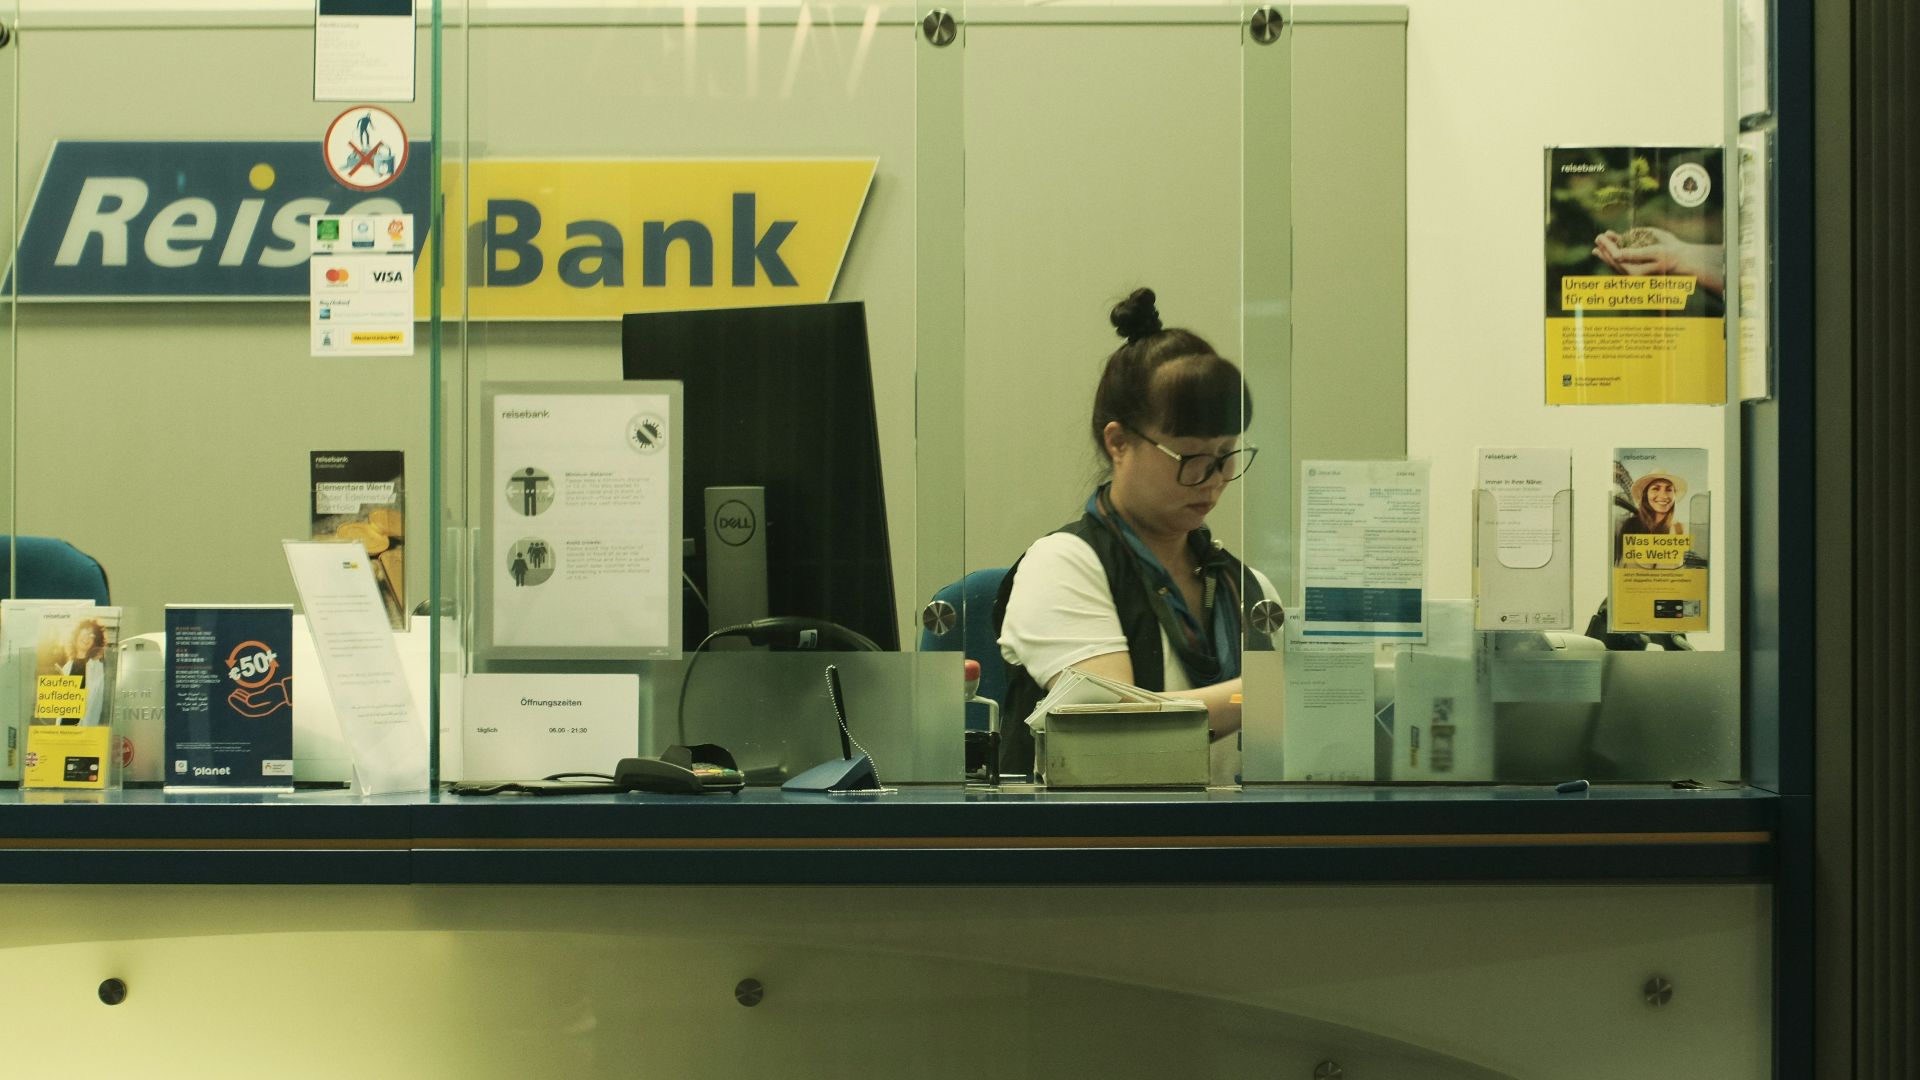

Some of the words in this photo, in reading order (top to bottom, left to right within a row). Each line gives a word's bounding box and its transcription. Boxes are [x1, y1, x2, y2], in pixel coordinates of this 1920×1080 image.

[1560, 162, 1606, 173] reisebank
[54, 163, 403, 268] Reis
[486, 192, 800, 289] Bank
[373, 271, 403, 283] VISA
[1565, 279, 1600, 290] Unser
[1603, 279, 1646, 290] aktiver
[1649, 279, 1693, 293] Beitrag
[1565, 294, 1583, 305] für
[1586, 295, 1605, 305] ein
[1608, 295, 1644, 307] gutes
[1647, 294, 1683, 305] Klima.
[502, 409, 550, 419] reisebank
[720, 517, 752, 529] DELL
[1625, 535, 1650, 546] Was
[1653, 535, 1690, 546] kostet
[1625, 549, 1642, 560] die
[1646, 549, 1679, 560] Welt?
[39, 677, 78, 689] Kaufen,
[38, 690, 84, 703] aufladen,
[520, 697, 582, 708] Öffnungszeiten
[37, 704, 81, 717] loslegen!
[477, 726, 498, 734] täglich
[193, 766, 231, 777] planet
